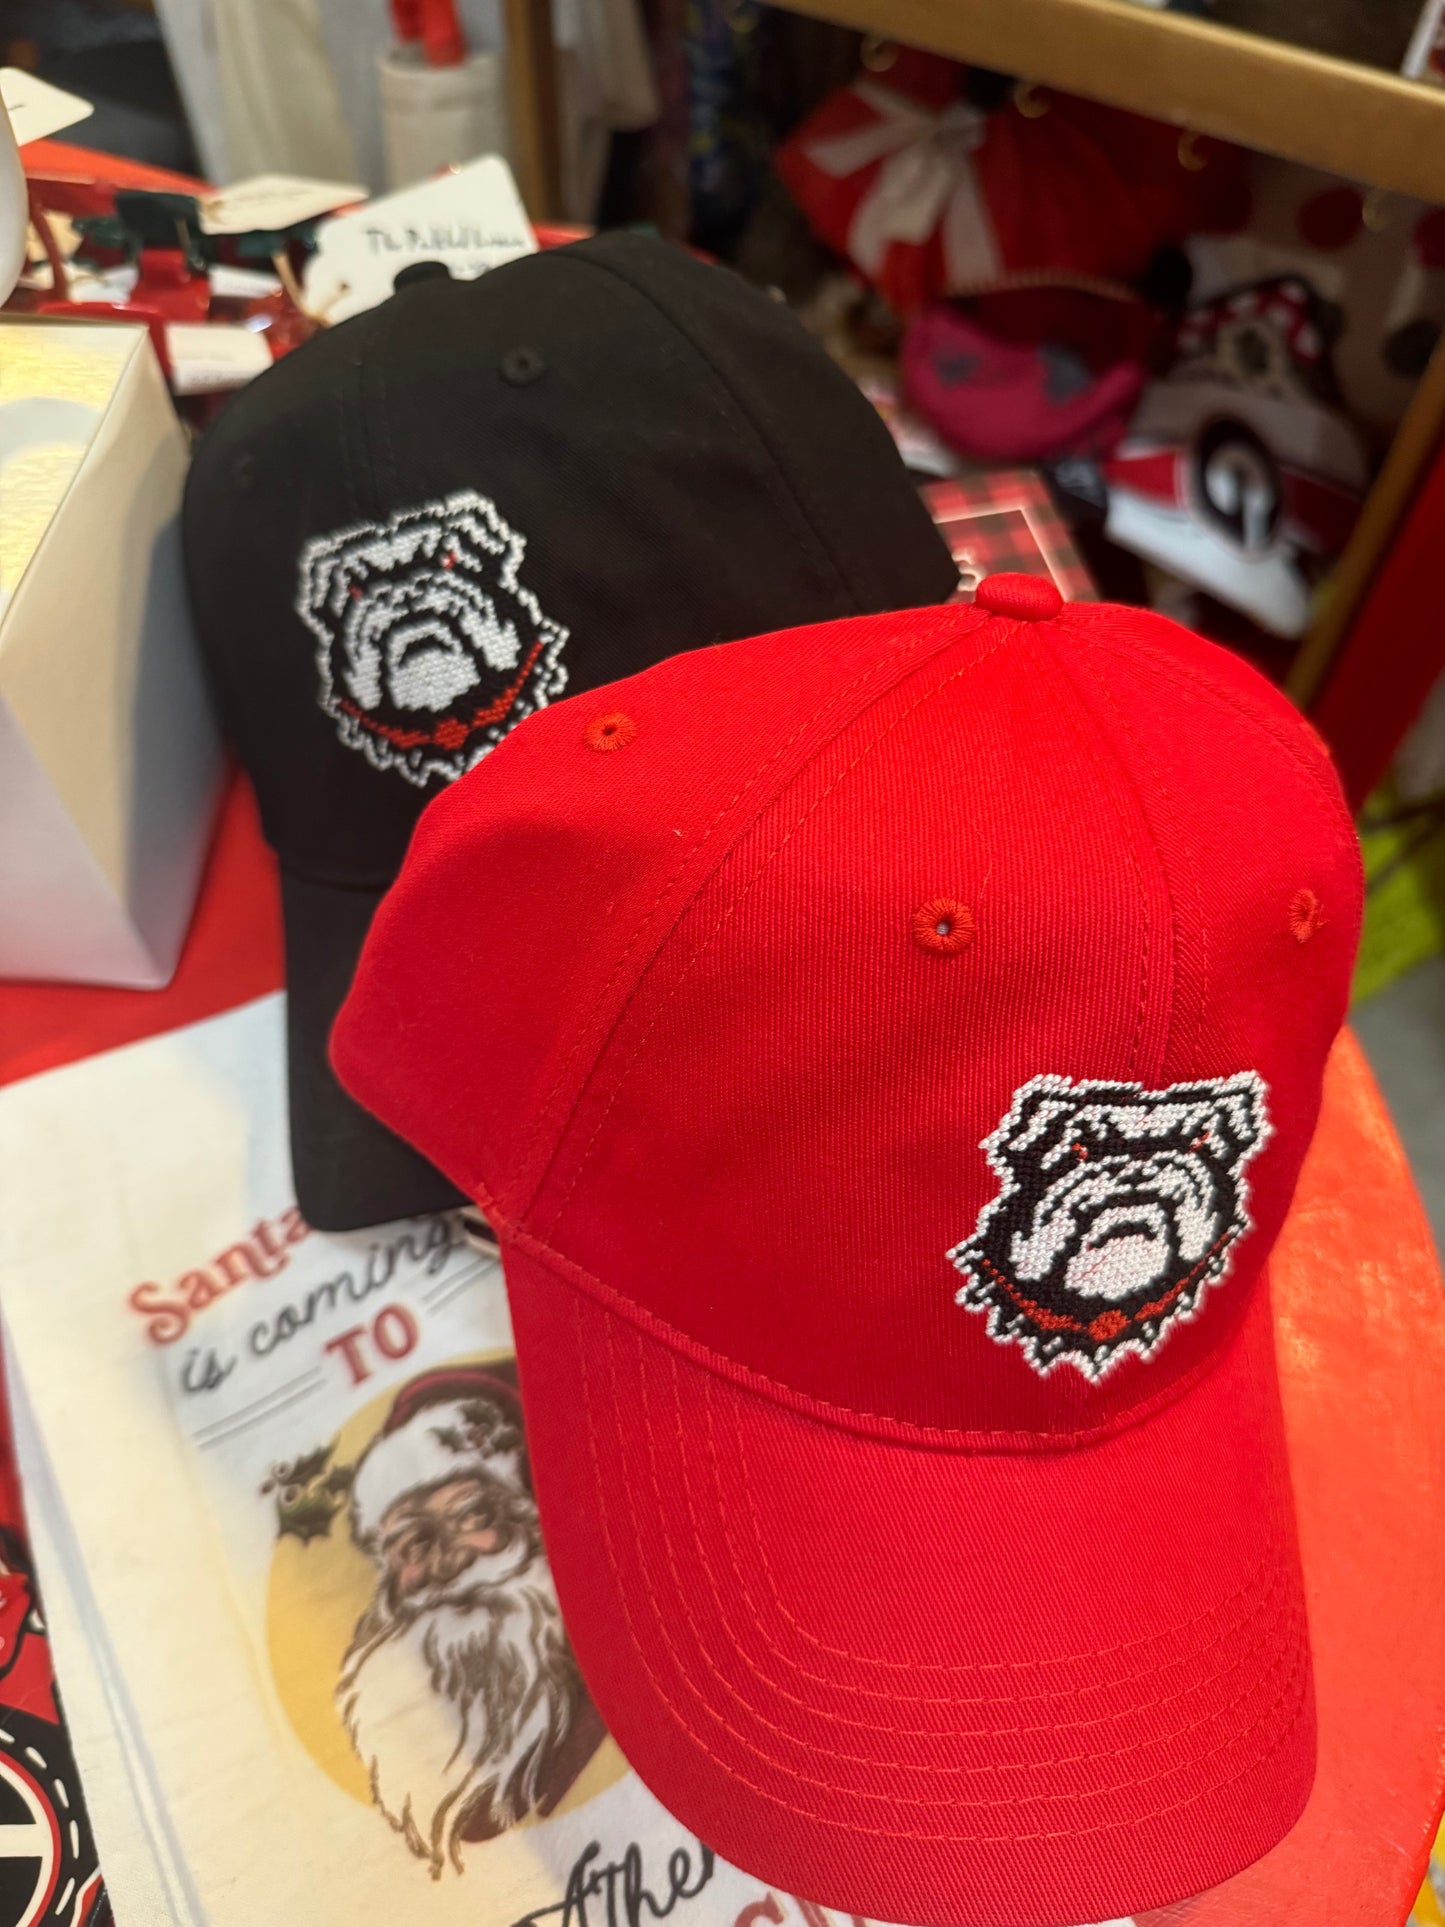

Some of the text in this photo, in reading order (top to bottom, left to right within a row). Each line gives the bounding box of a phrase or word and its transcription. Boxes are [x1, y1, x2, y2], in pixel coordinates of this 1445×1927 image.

[127, 1203, 316, 1348] Santa
[180, 1215, 466, 1396] is coming
[325, 1302, 420, 1390] TO
